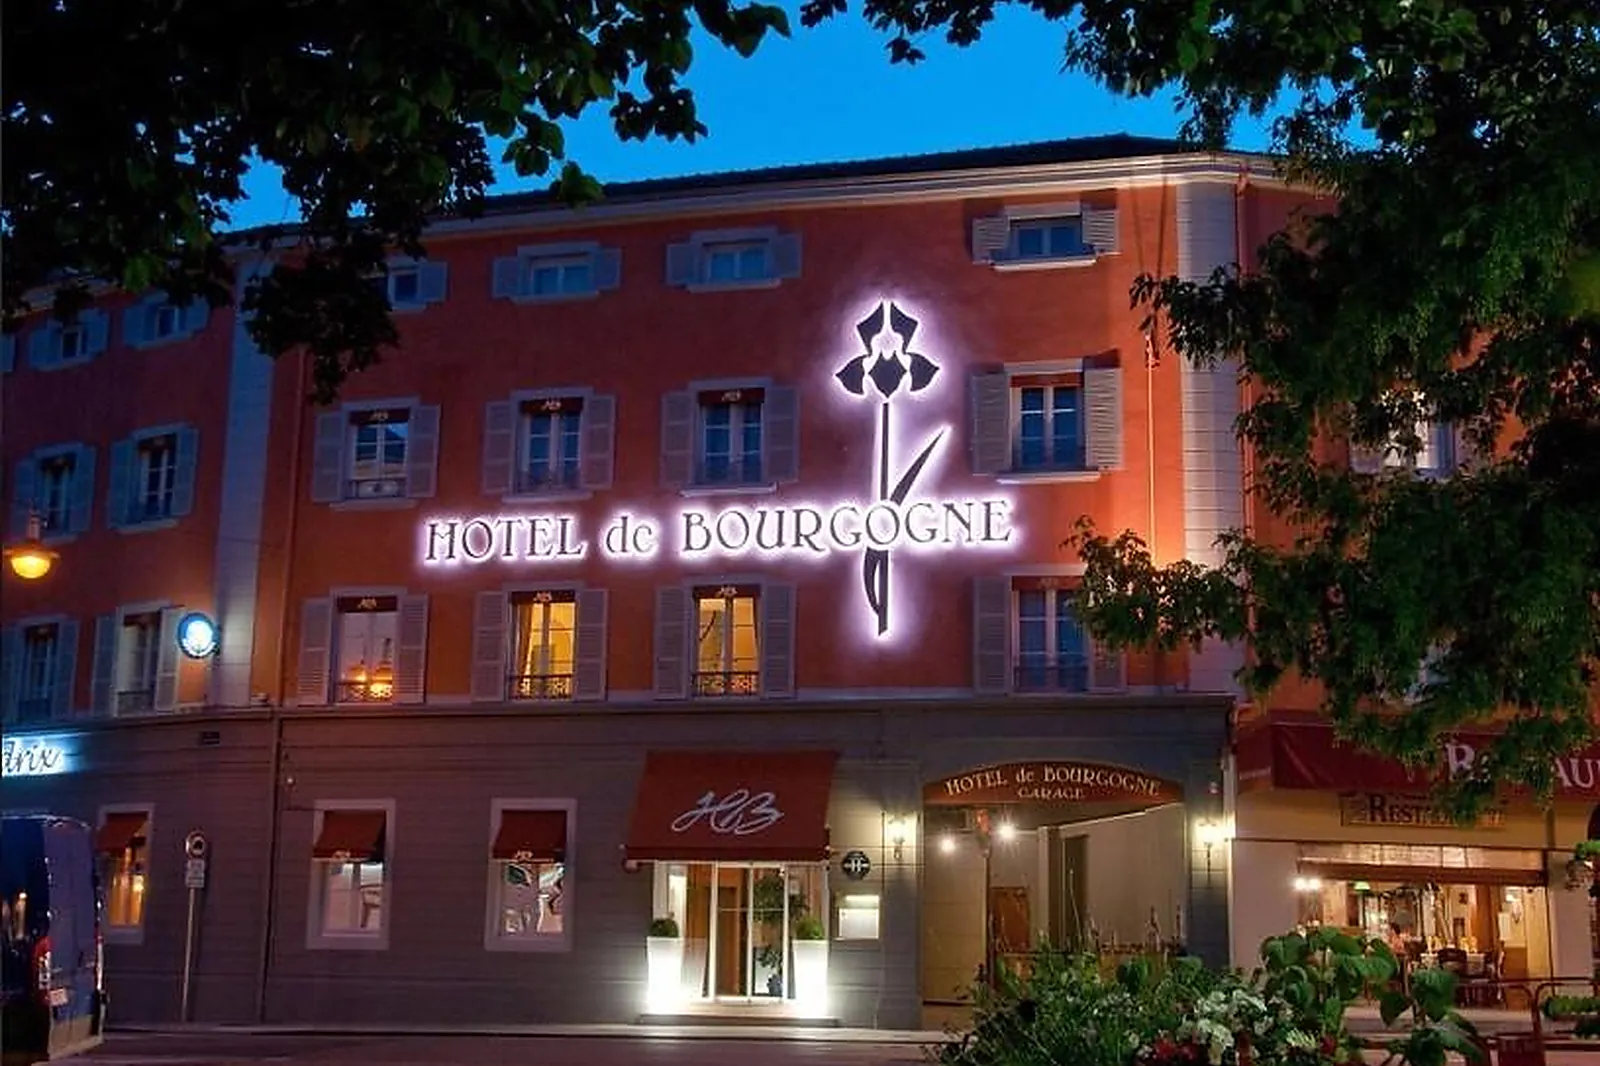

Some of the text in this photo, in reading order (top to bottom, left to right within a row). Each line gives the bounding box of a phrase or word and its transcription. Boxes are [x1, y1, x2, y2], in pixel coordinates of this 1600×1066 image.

[425, 516, 583, 560] HOTEL
[682, 499, 1013, 552] BOURGOGNE
[945, 763, 1163, 797] HOTEL de BOURGOGNE
[1017, 787, 1085, 799] GARAGE
